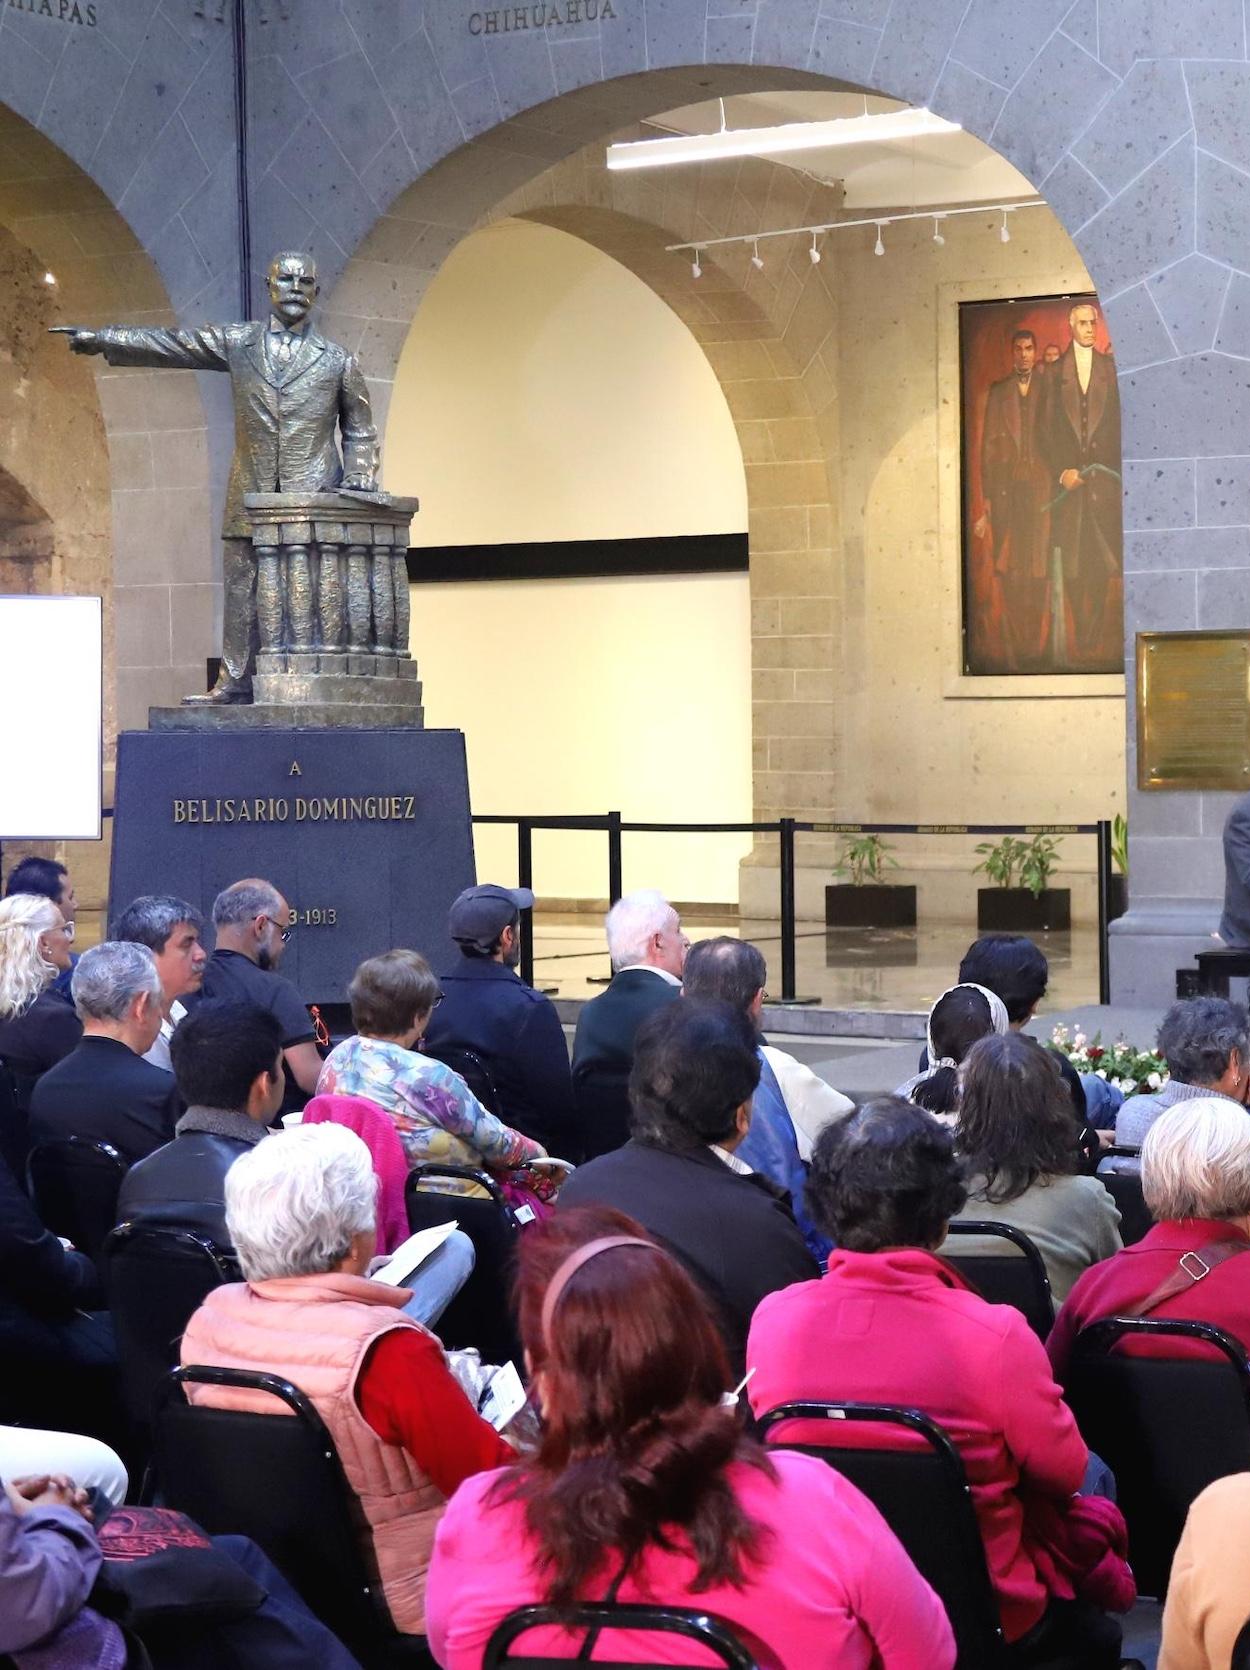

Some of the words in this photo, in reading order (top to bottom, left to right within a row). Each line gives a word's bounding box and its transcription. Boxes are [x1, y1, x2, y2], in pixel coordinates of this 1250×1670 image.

[468, 0, 617, 36] CHIHUAHUA
[288, 760, 302, 776] A
[173, 799, 289, 823] BELISARIO
[295, 796, 416, 821] DOMINGUEZ
[288, 908, 337, 925] 3-1913
